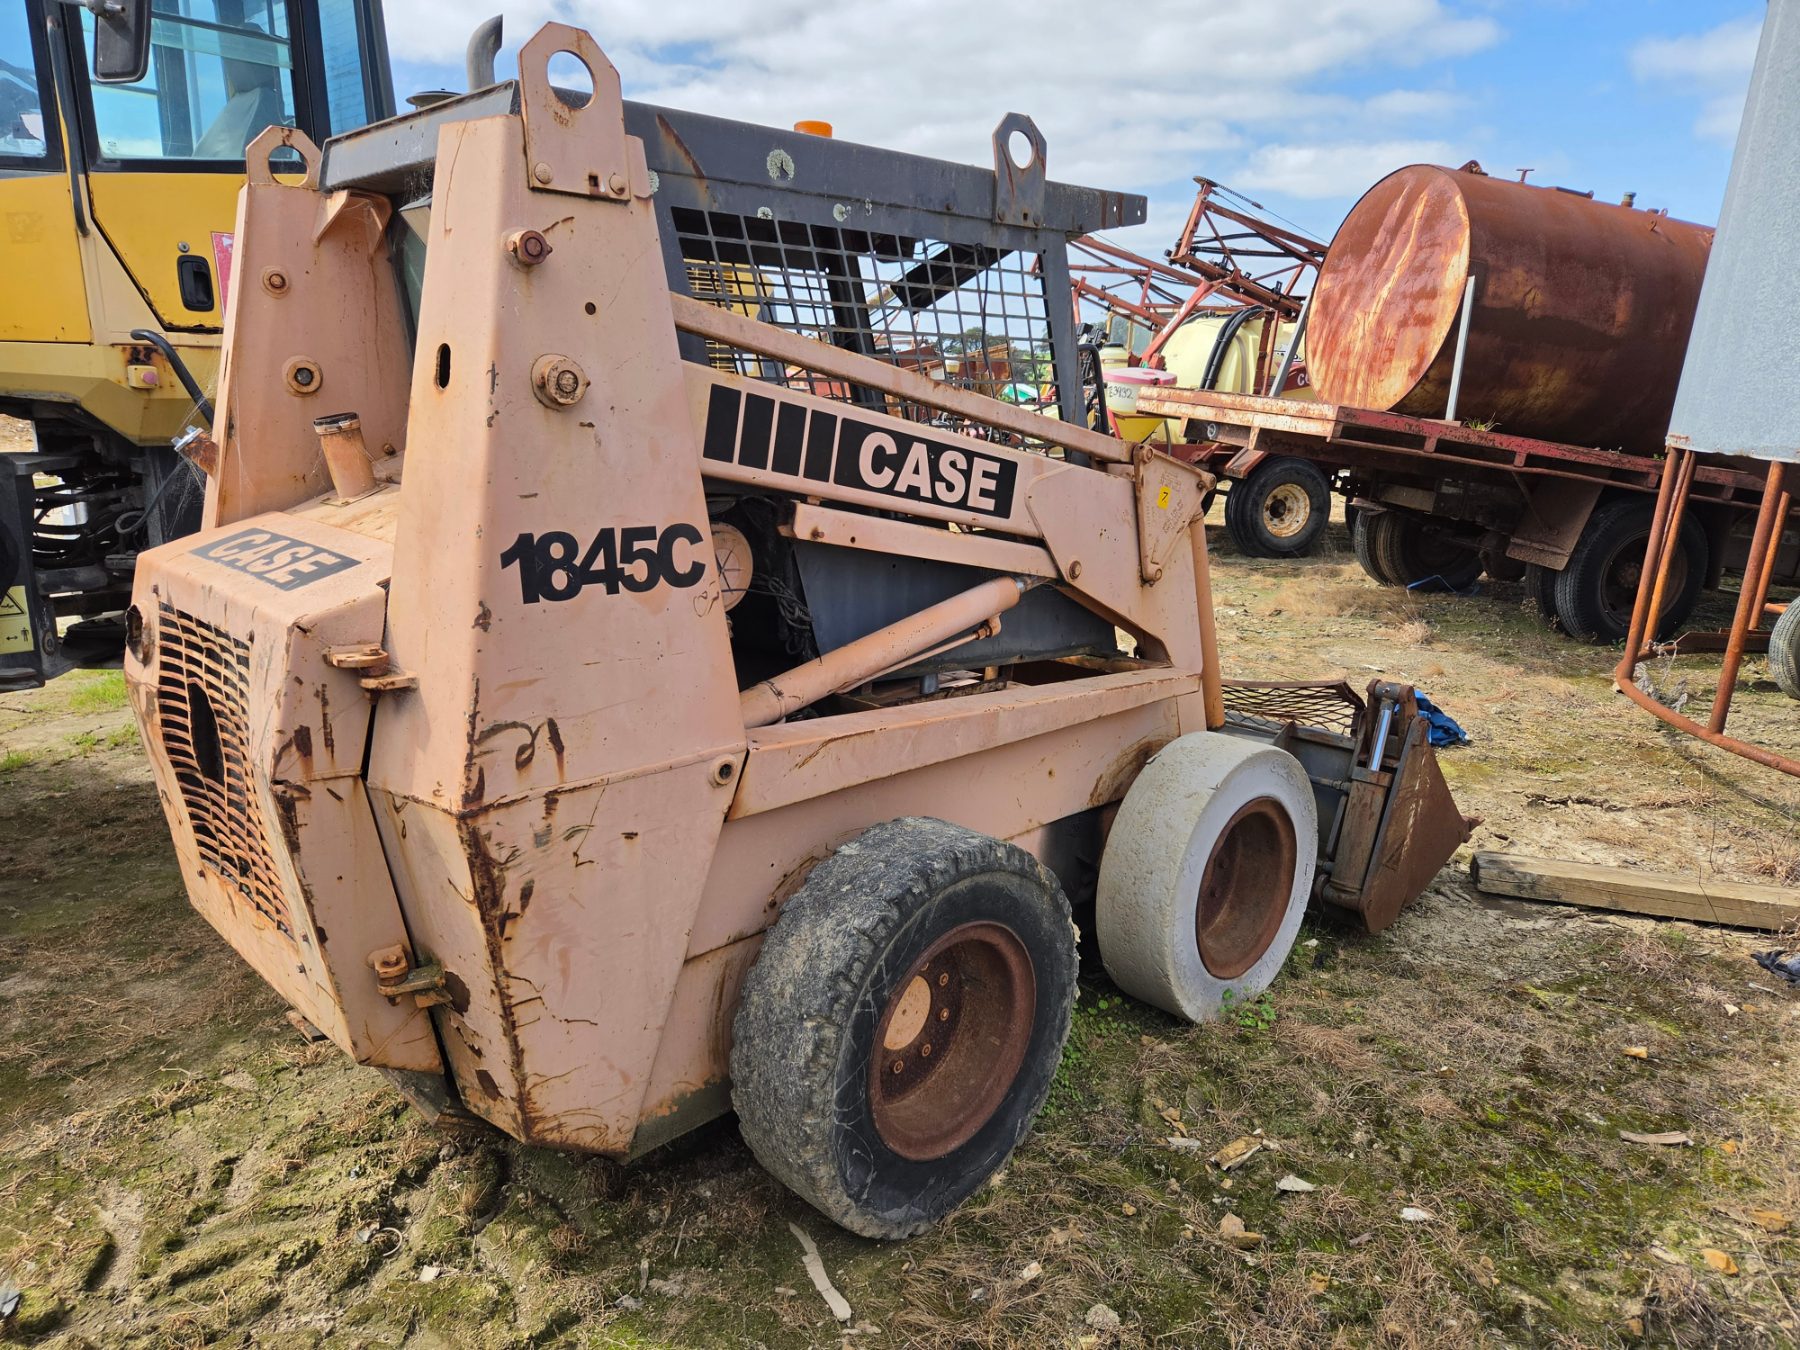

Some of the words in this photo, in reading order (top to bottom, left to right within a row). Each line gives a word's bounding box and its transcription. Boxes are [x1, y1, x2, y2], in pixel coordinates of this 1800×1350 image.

[858, 431, 1001, 511] CASE
[207, 532, 343, 584] CASE
[499, 522, 707, 605] 1845C
